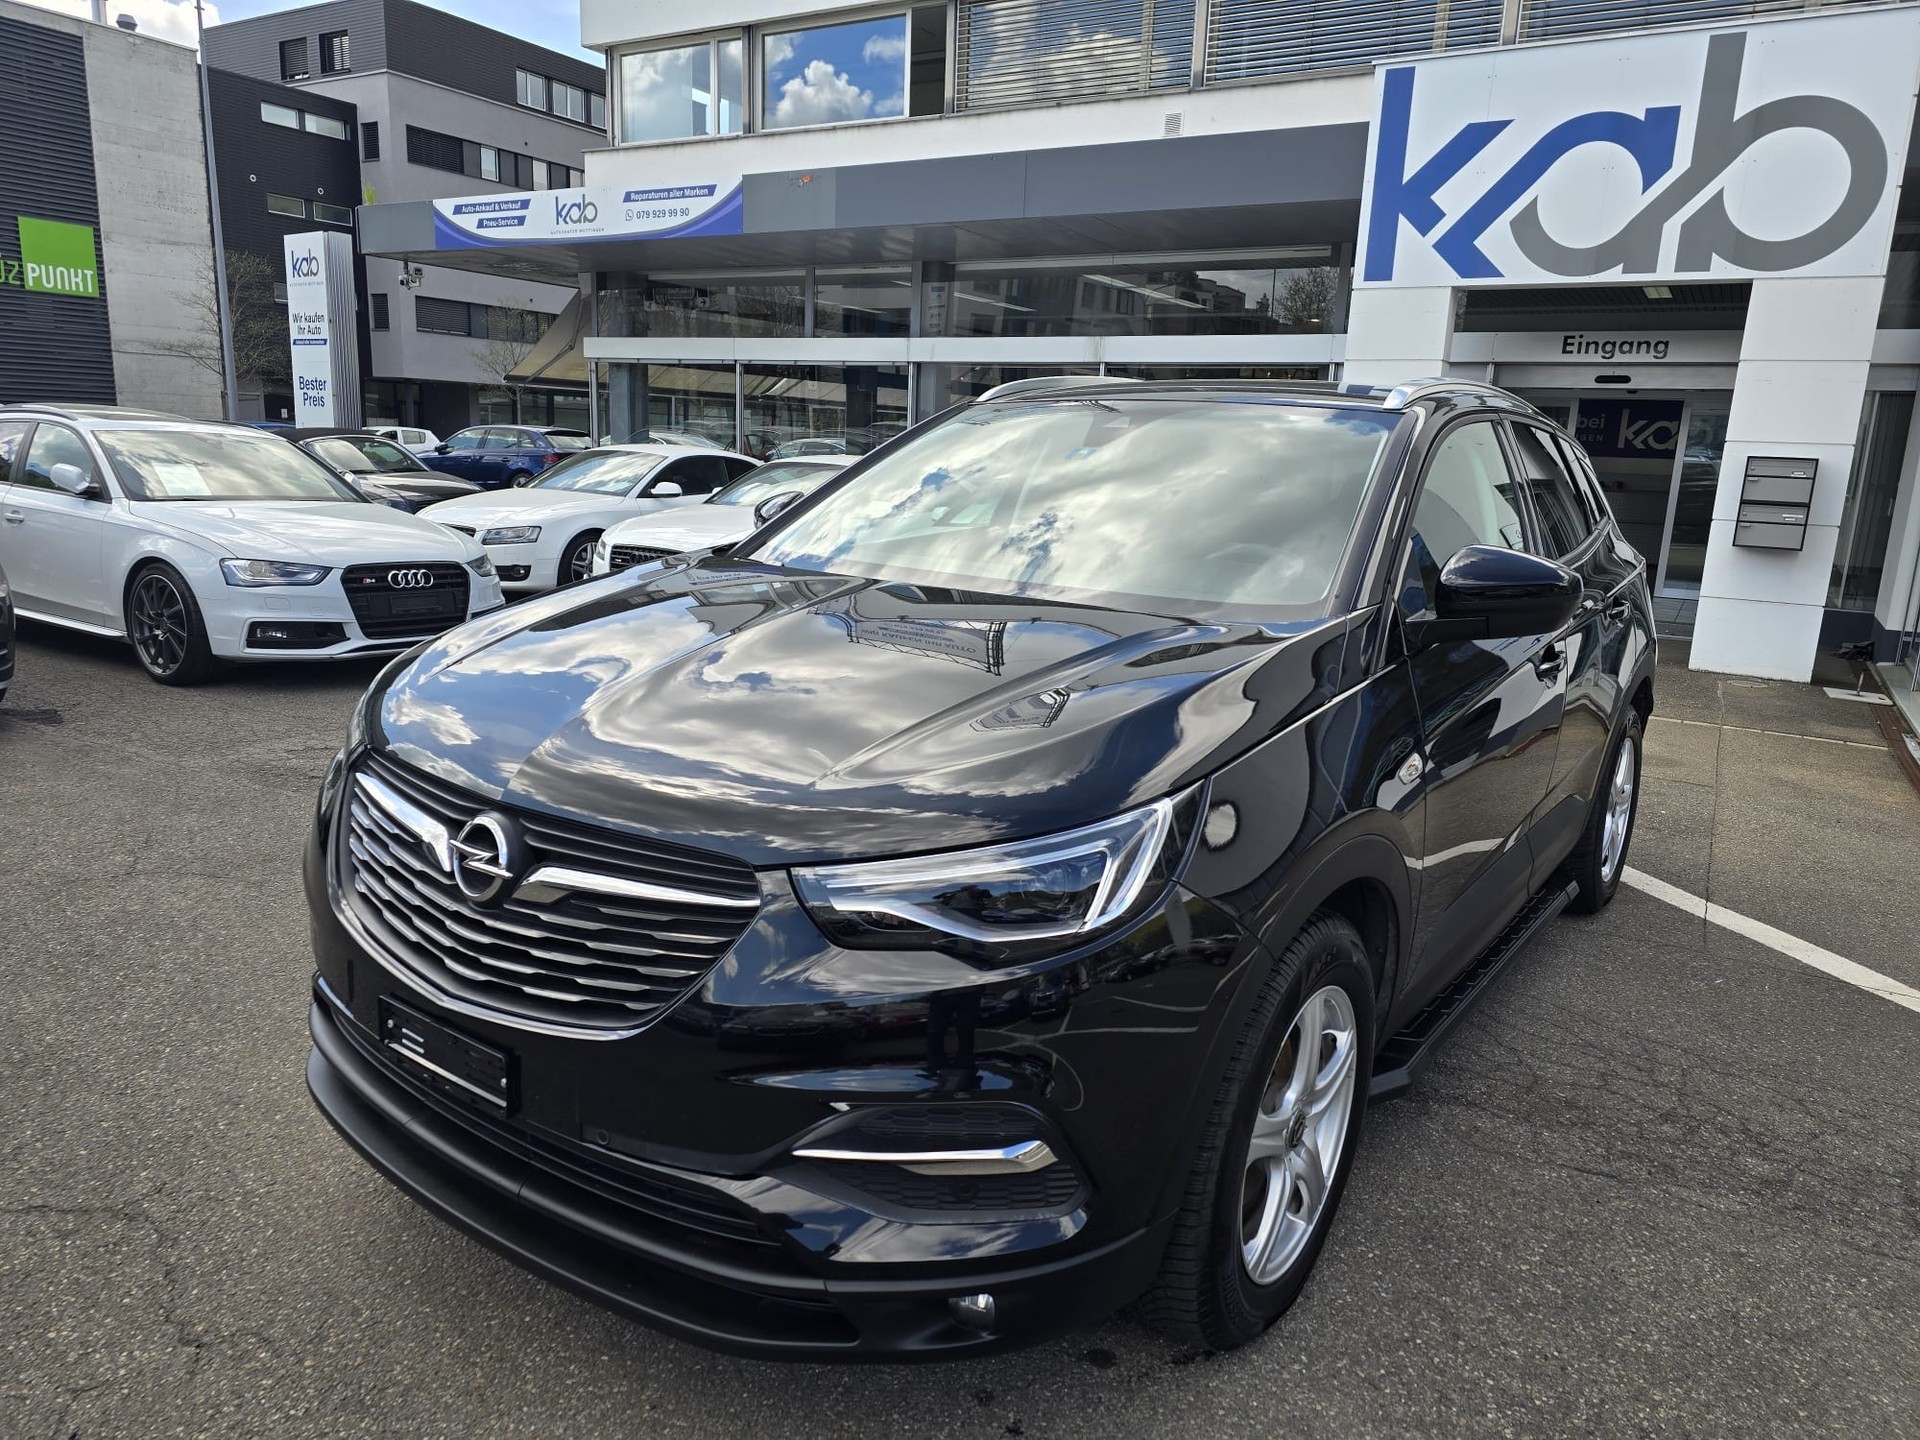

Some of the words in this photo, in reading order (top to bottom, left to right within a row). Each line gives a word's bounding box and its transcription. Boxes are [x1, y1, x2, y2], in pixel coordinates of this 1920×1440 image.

[1363, 31, 1889, 282] kab
[630, 191, 668, 202] Reparaturen
[669, 189, 683, 199] aller
[684, 187, 709, 197] Marken
[555, 194, 598, 226] kab
[636, 210, 650, 219] 079
[652, 209, 666, 218] 929
[668, 208, 678, 217] 99
[679, 207, 690, 217] 90
[291, 248, 320, 278] kab
[26, 262, 94, 293] PUNKT
[292, 312, 303, 323] Wir
[303, 311, 326, 323] kaufen
[297, 325, 306, 335] Ihr
[307, 325, 322, 335] Auto
[1561, 335, 1670, 359] Eingang
[298, 375, 328, 391] Bester
[302, 391, 326, 407] Preis
[1577, 412, 1606, 429] bei
[1617, 408, 1680, 450] ka
